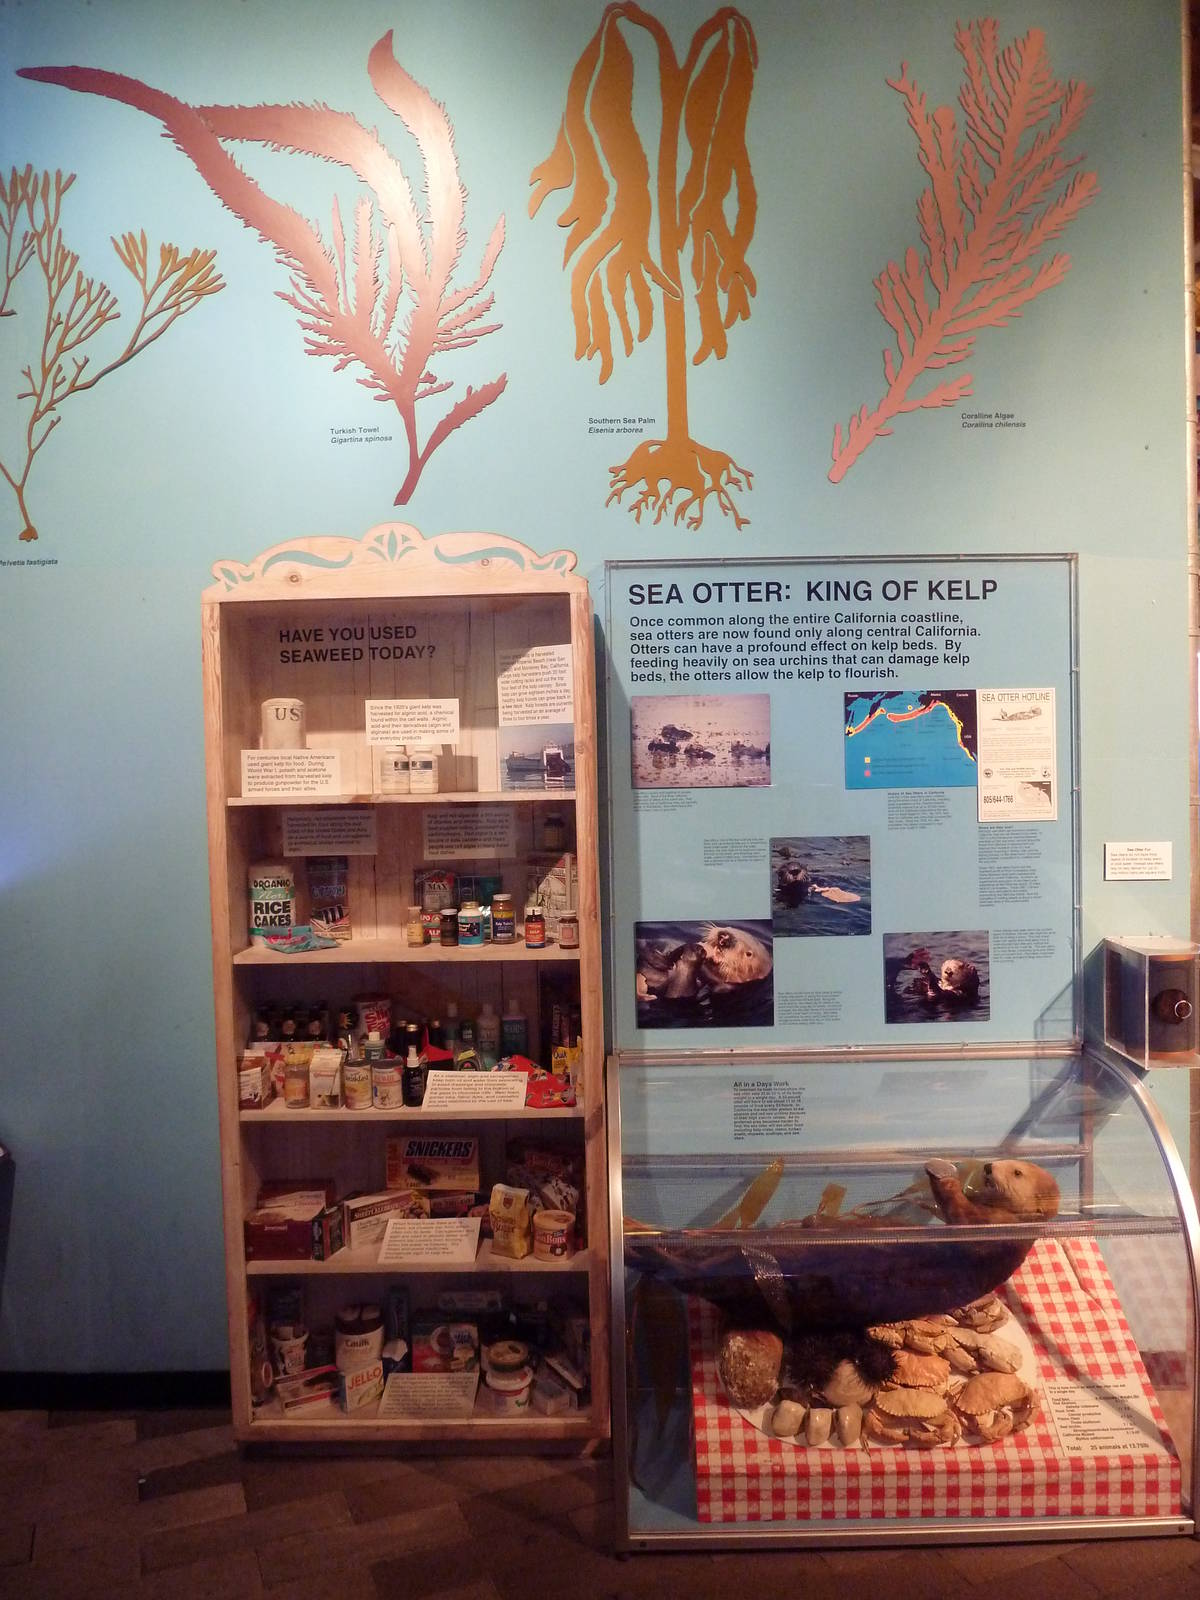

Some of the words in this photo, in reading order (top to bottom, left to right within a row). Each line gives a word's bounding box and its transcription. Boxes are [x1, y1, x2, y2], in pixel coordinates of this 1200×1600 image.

[994, 412, 1014, 420] Algae
[331, 437, 363, 445] Gigartina
[629, 583, 683, 605] SEA
[692, 581, 790, 603] OTTER:
[807, 580, 872, 602] KING
[882, 579, 918, 601] OF
[928, 579, 997, 600] KELP
[629, 616, 663, 627] Once
[667, 616, 726, 626] common
[727, 614, 765, 629] along
[768, 613, 790, 624] the
[793, 613, 830, 624] entire
[834, 612, 896, 623] California
[900, 612, 965, 628] coastline,
[279, 628, 324, 643] HAVE
[328, 627, 364, 641] YOU
[368, 625, 416, 640] USED
[629, 632, 653, 640] sea
[656, 629, 696, 640] otters
[695, 630, 718, 639] are
[722, 630, 749, 639] now
[753, 627, 790, 638] found
[794, 627, 823, 642] only
[824, 627, 863, 642] along
[865, 626, 913, 636] central
[915, 625, 982, 637] California.
[279, 648, 363, 663] SEAWEED
[368, 645, 436, 660] TODAY?
[630, 643, 671, 654] Otters
[674, 643, 698, 653] can
[700, 642, 732, 654] have
[736, 644, 743, 652] a
[747, 641, 806, 655] profound
[809, 640, 849, 651] effect
[849, 642, 869, 650] on
[871, 639, 898, 655] kelp
[902, 639, 937, 650] beds.
[943, 639, 962, 654] By
[630, 655, 678, 670] feeding
[683, 655, 728, 669] heavily
[732, 657, 751, 666] on
[752, 656, 775, 666] sea
[779, 654, 830, 665] urchins
[829, 654, 858, 664] that
[861, 655, 886, 664] can
[885, 652, 941, 668] damage
[941, 652, 970, 666] kelp
[630, 669, 666, 683] beds,
[669, 669, 690, 681] the
[694, 668, 731, 680] otters
[735, 669, 769, 680] allow
[773, 668, 793, 679] the
[796, 667, 824, 682] kelp
[828, 667, 841, 678] to
[844, 667, 898, 678] flourish.
[981, 693, 996, 702] SEA
[997, 692, 1020, 702] OTTER
[1021, 692, 1050, 702] HOTLINE
[253, 879, 290, 891] ORGANIC
[254, 901, 291, 914] RICE
[254, 914, 291, 927] CAKES
[406, 1141, 473, 1157] SNICKERS
